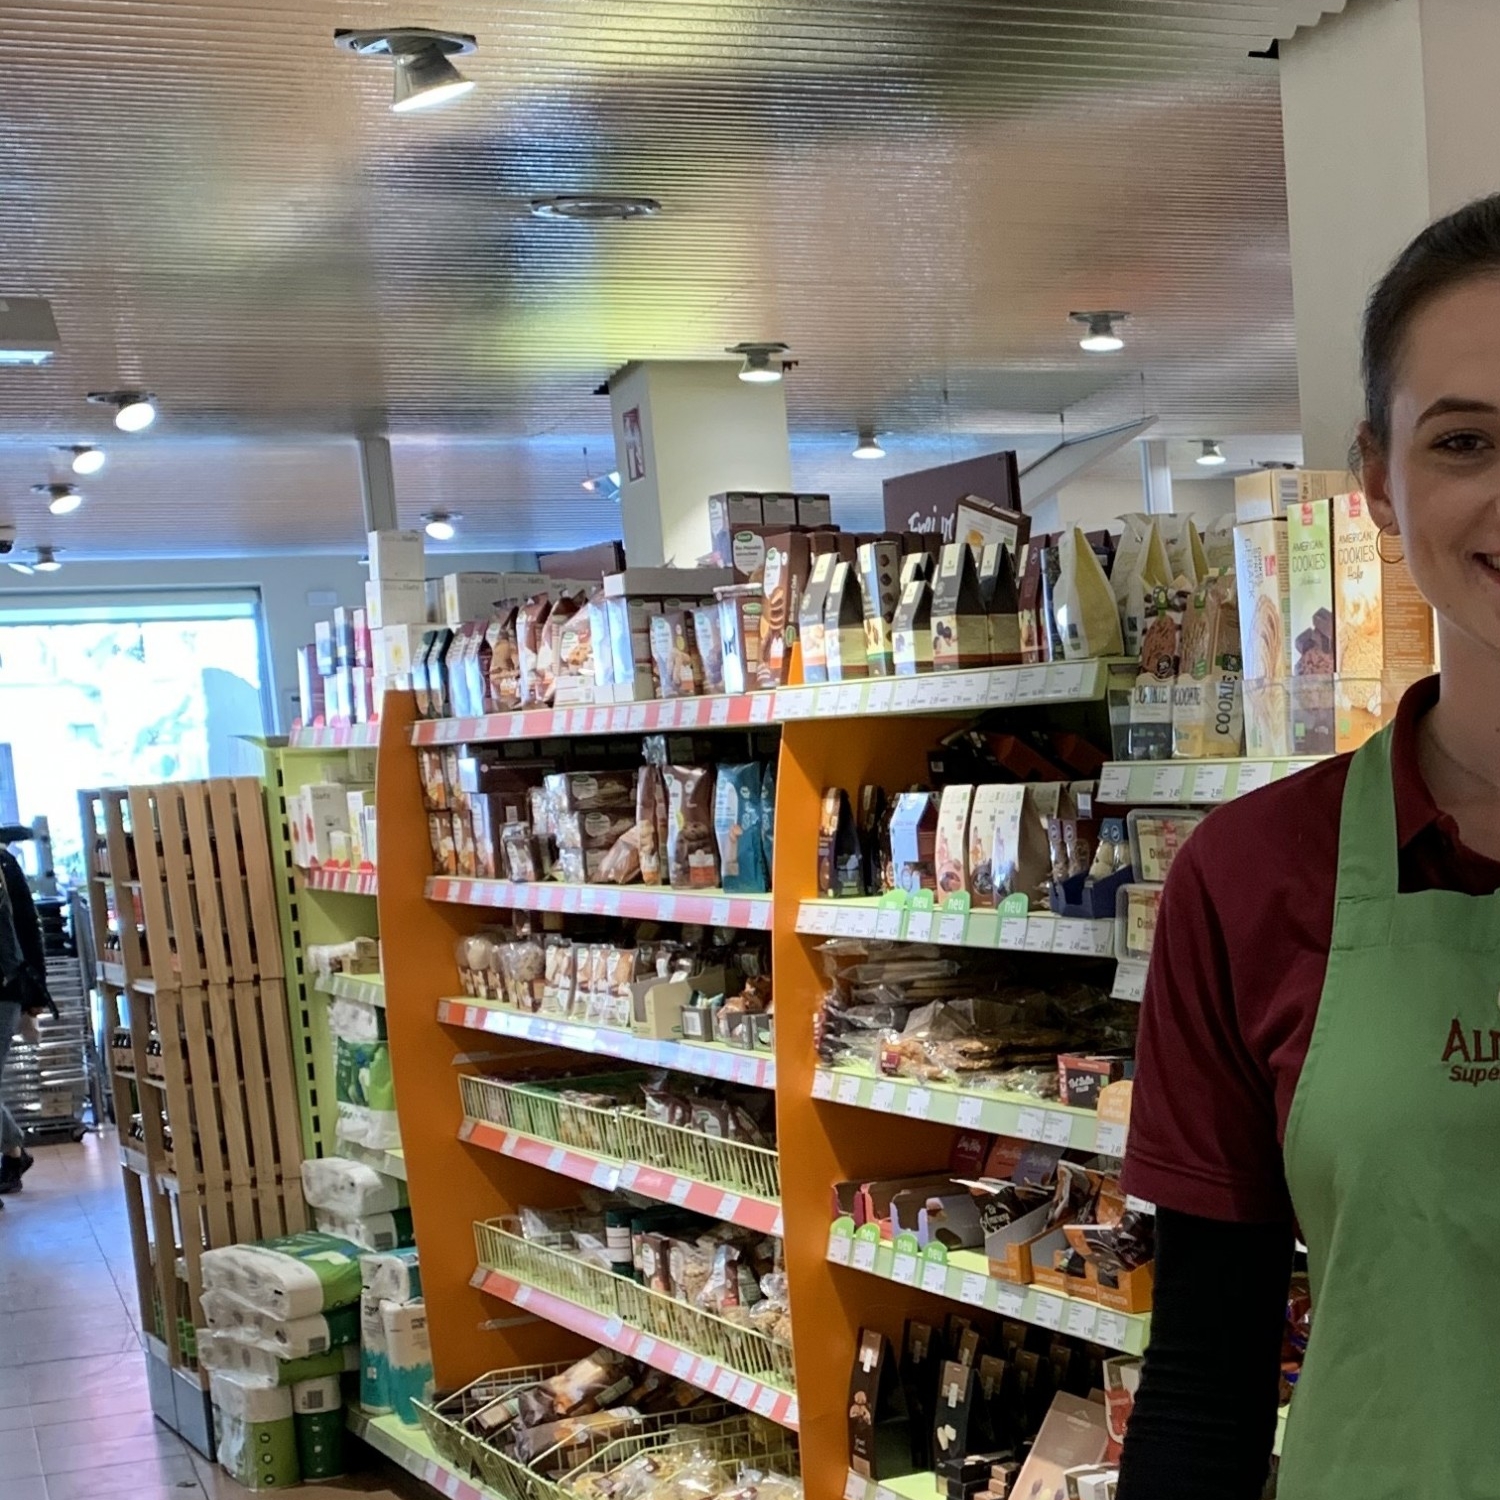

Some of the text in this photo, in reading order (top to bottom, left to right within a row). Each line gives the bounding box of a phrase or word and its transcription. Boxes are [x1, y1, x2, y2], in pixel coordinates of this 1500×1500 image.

[1338, 545, 1374, 565] COOKIES
[1292, 554, 1326, 572] COOKIES
[912, 896, 930, 910] neu
[947, 898, 966, 912] neu
[1003, 900, 1022, 914] neu
